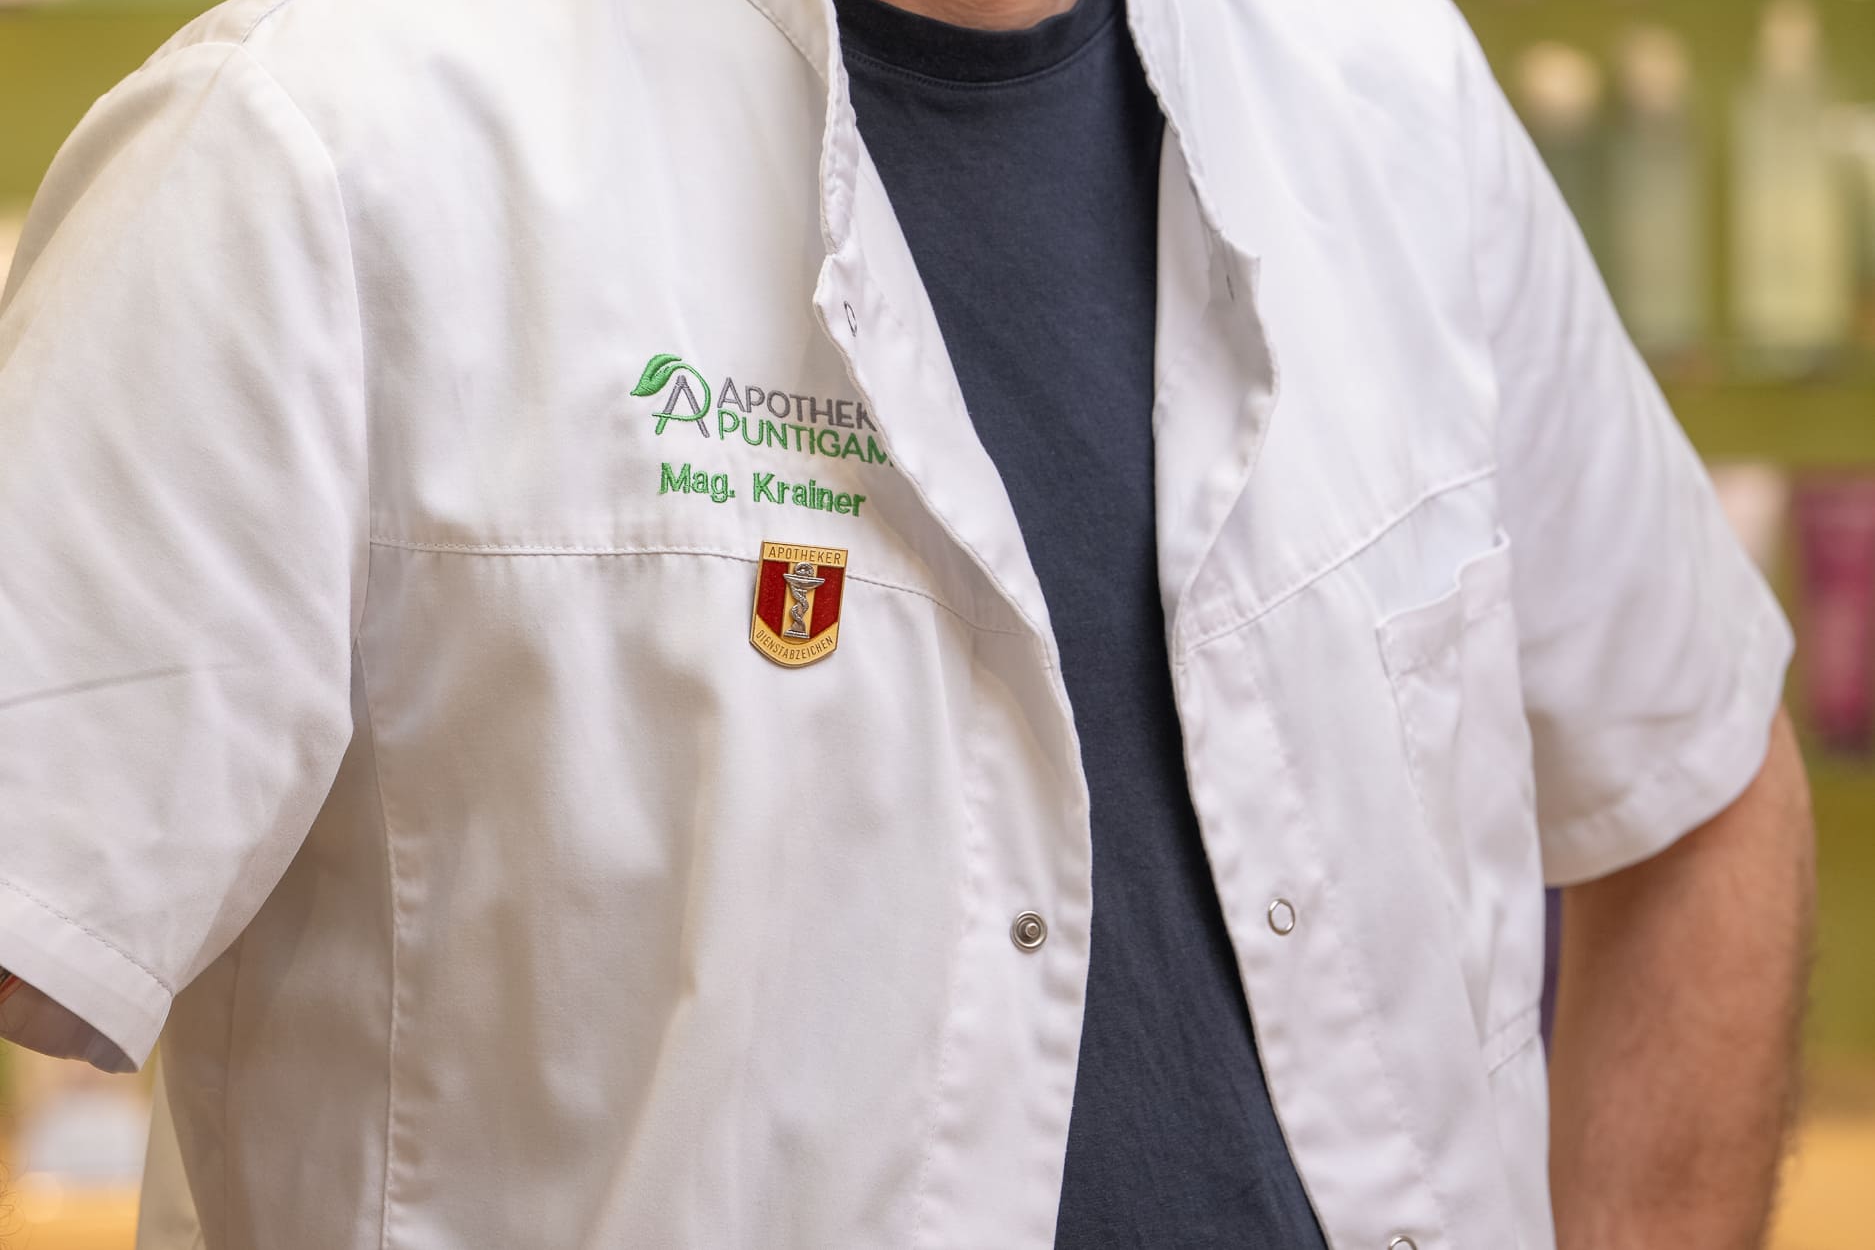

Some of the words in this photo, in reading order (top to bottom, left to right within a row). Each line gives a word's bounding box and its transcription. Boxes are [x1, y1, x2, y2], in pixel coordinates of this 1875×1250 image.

[717, 376, 877, 432] APOTHEK
[717, 409, 893, 467] PUNTIGAM
[658, 461, 736, 503] Mag.
[753, 471, 866, 517] Krainer
[768, 546, 841, 565] APOTHEKER
[756, 629, 833, 660] DIENSTABZEICHEN
